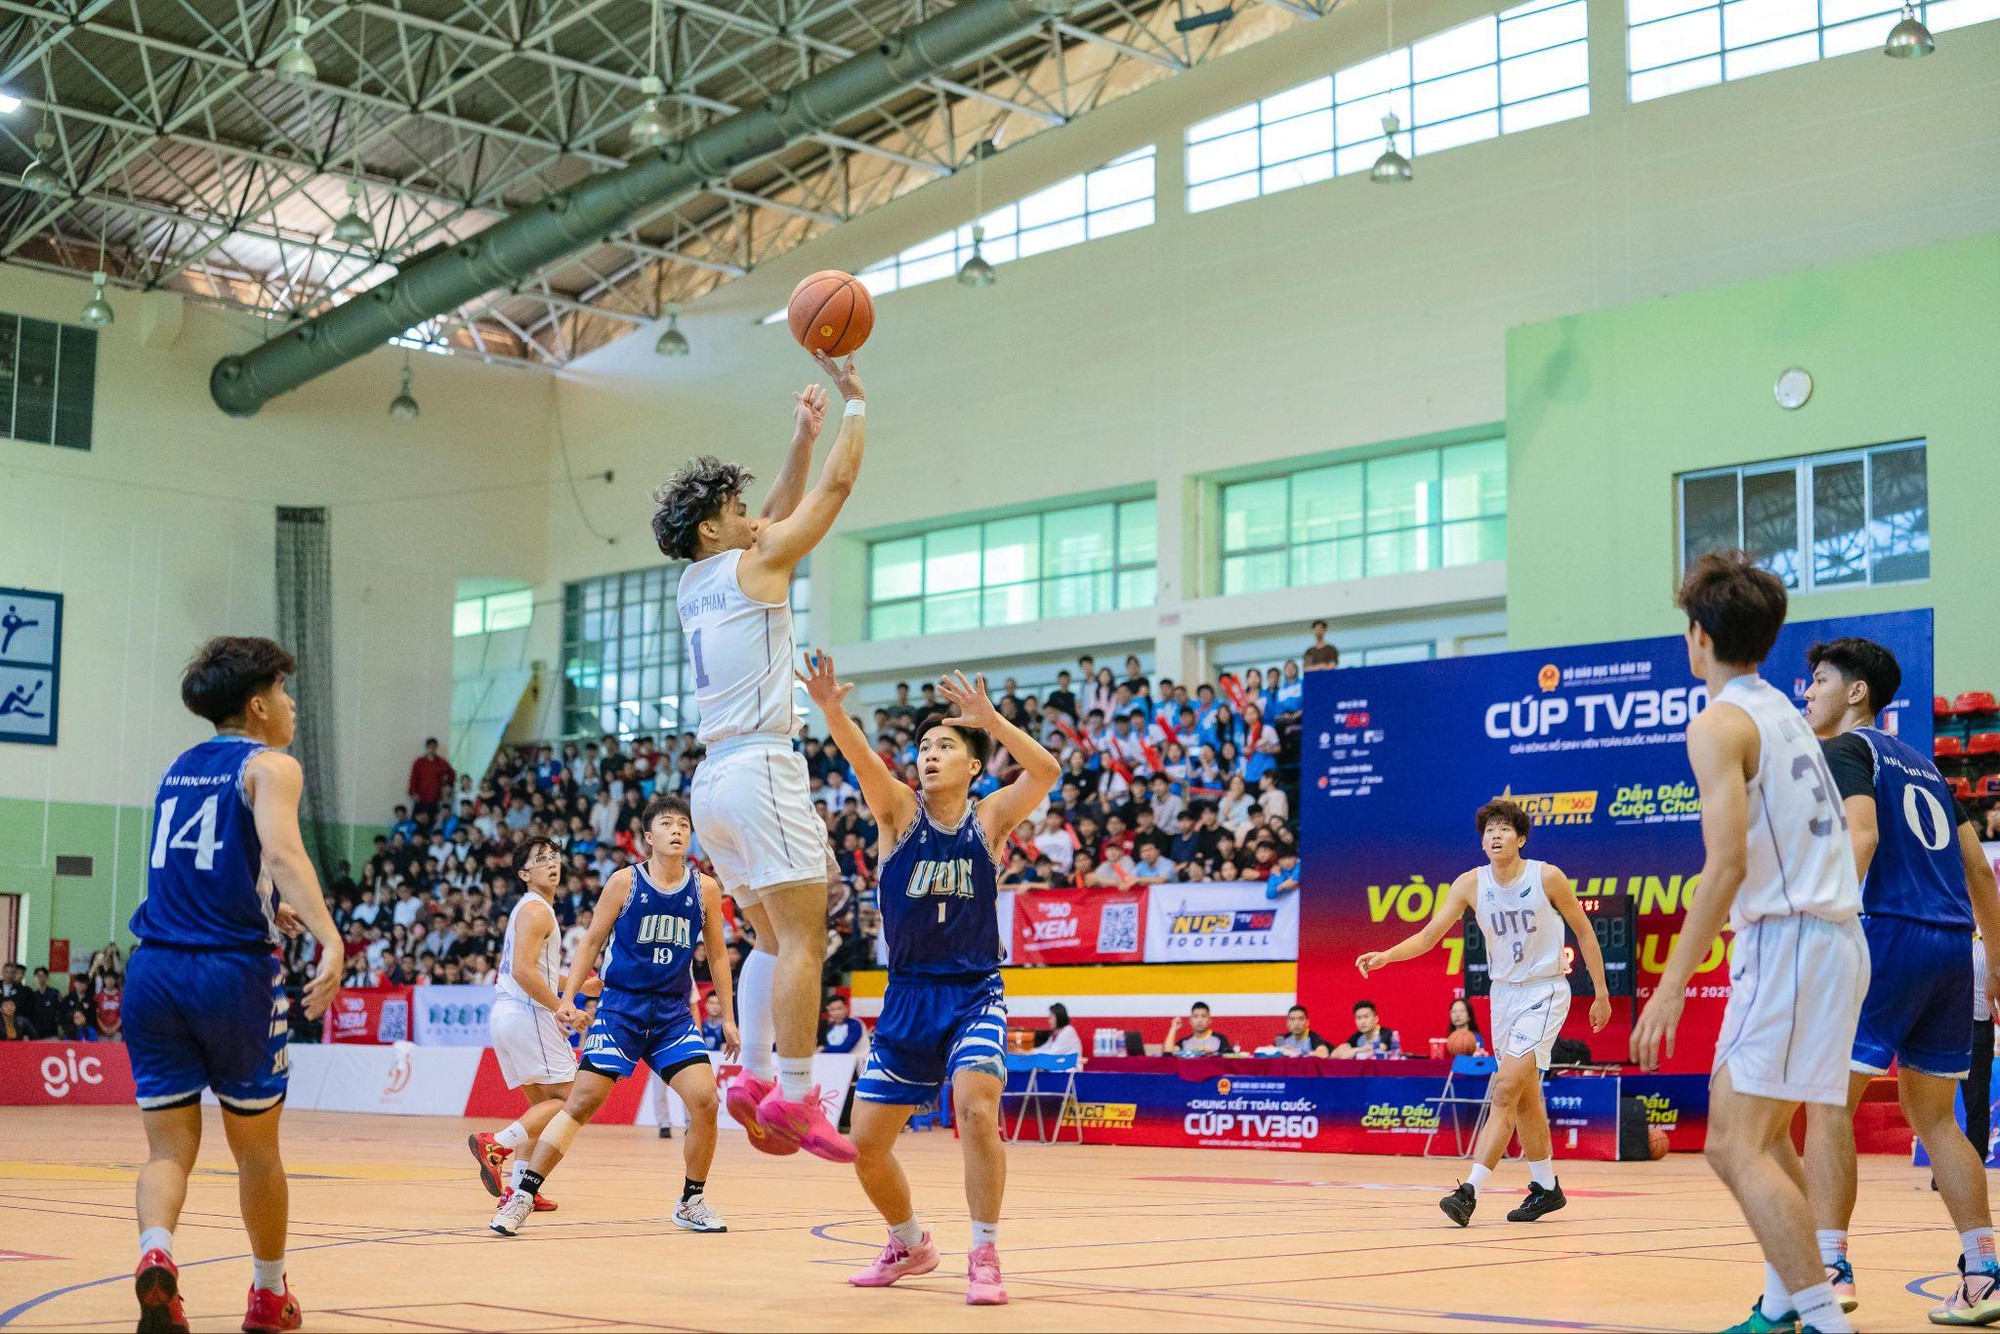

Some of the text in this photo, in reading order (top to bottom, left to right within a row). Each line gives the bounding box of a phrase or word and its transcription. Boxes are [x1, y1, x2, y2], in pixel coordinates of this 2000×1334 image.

[691, 627, 710, 690] 1
[1485, 685, 1710, 739] CÚP TV360
[1903, 783, 1951, 851] 0
[151, 795, 224, 871] 14
[938, 902, 947, 924] 1
[1490, 908, 1537, 937] UTC
[1033, 918, 1079, 942] XEM
[1167, 935, 1269, 948] FOOTBALL
[653, 947, 673, 965] 19
[1512, 940, 1524, 964] 8
[41, 1048, 103, 1098] gic
[1191, 1099, 1227, 1110] CHUNG
[1249, 1098, 1279, 1111] TOÀN
[1280, 1097, 1312, 1112] QUỐC
[1184, 1110, 1319, 1139] CÚP TV360
